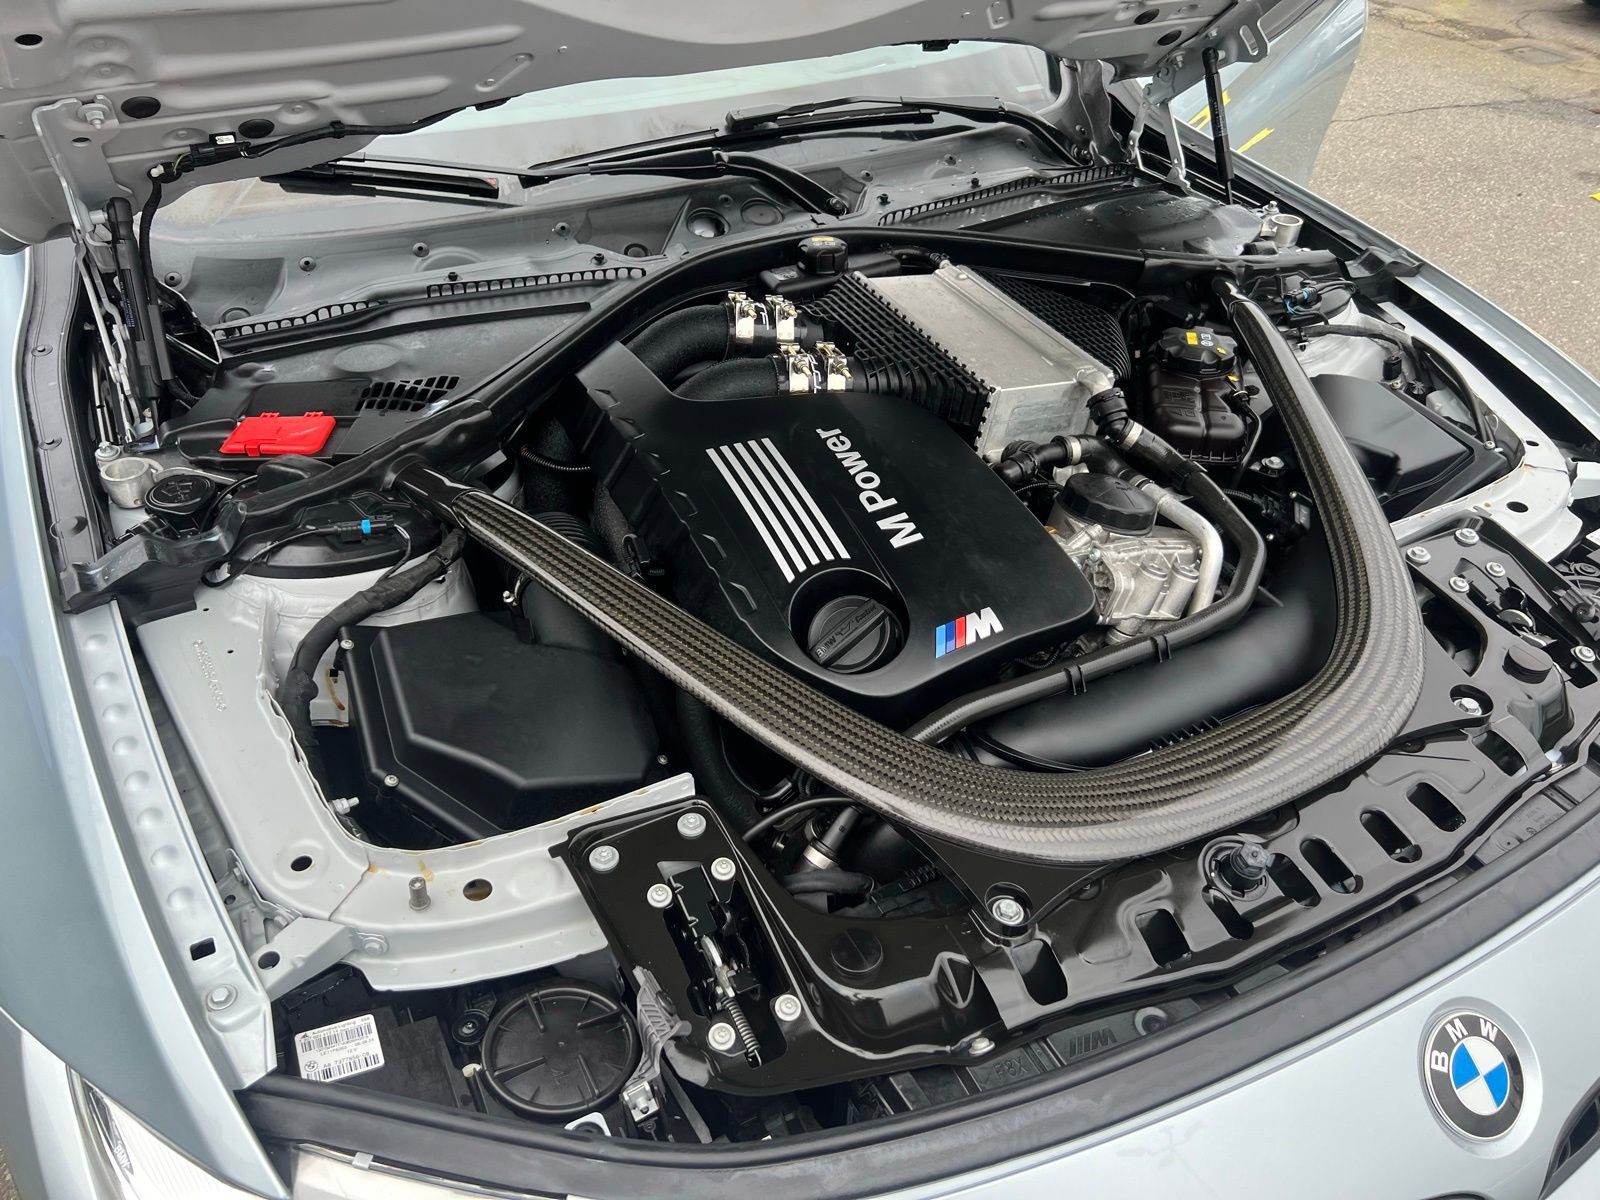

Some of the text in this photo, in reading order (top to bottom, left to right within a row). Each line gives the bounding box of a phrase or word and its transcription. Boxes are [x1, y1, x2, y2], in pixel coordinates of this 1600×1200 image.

[815, 428, 924, 549] M Power
[815, 635, 837, 658] BMW
[1430, 1017, 1498, 1073] BMW
[993, 1057, 1028, 1077] F8X
[114, 1144, 130, 1168] BMW
